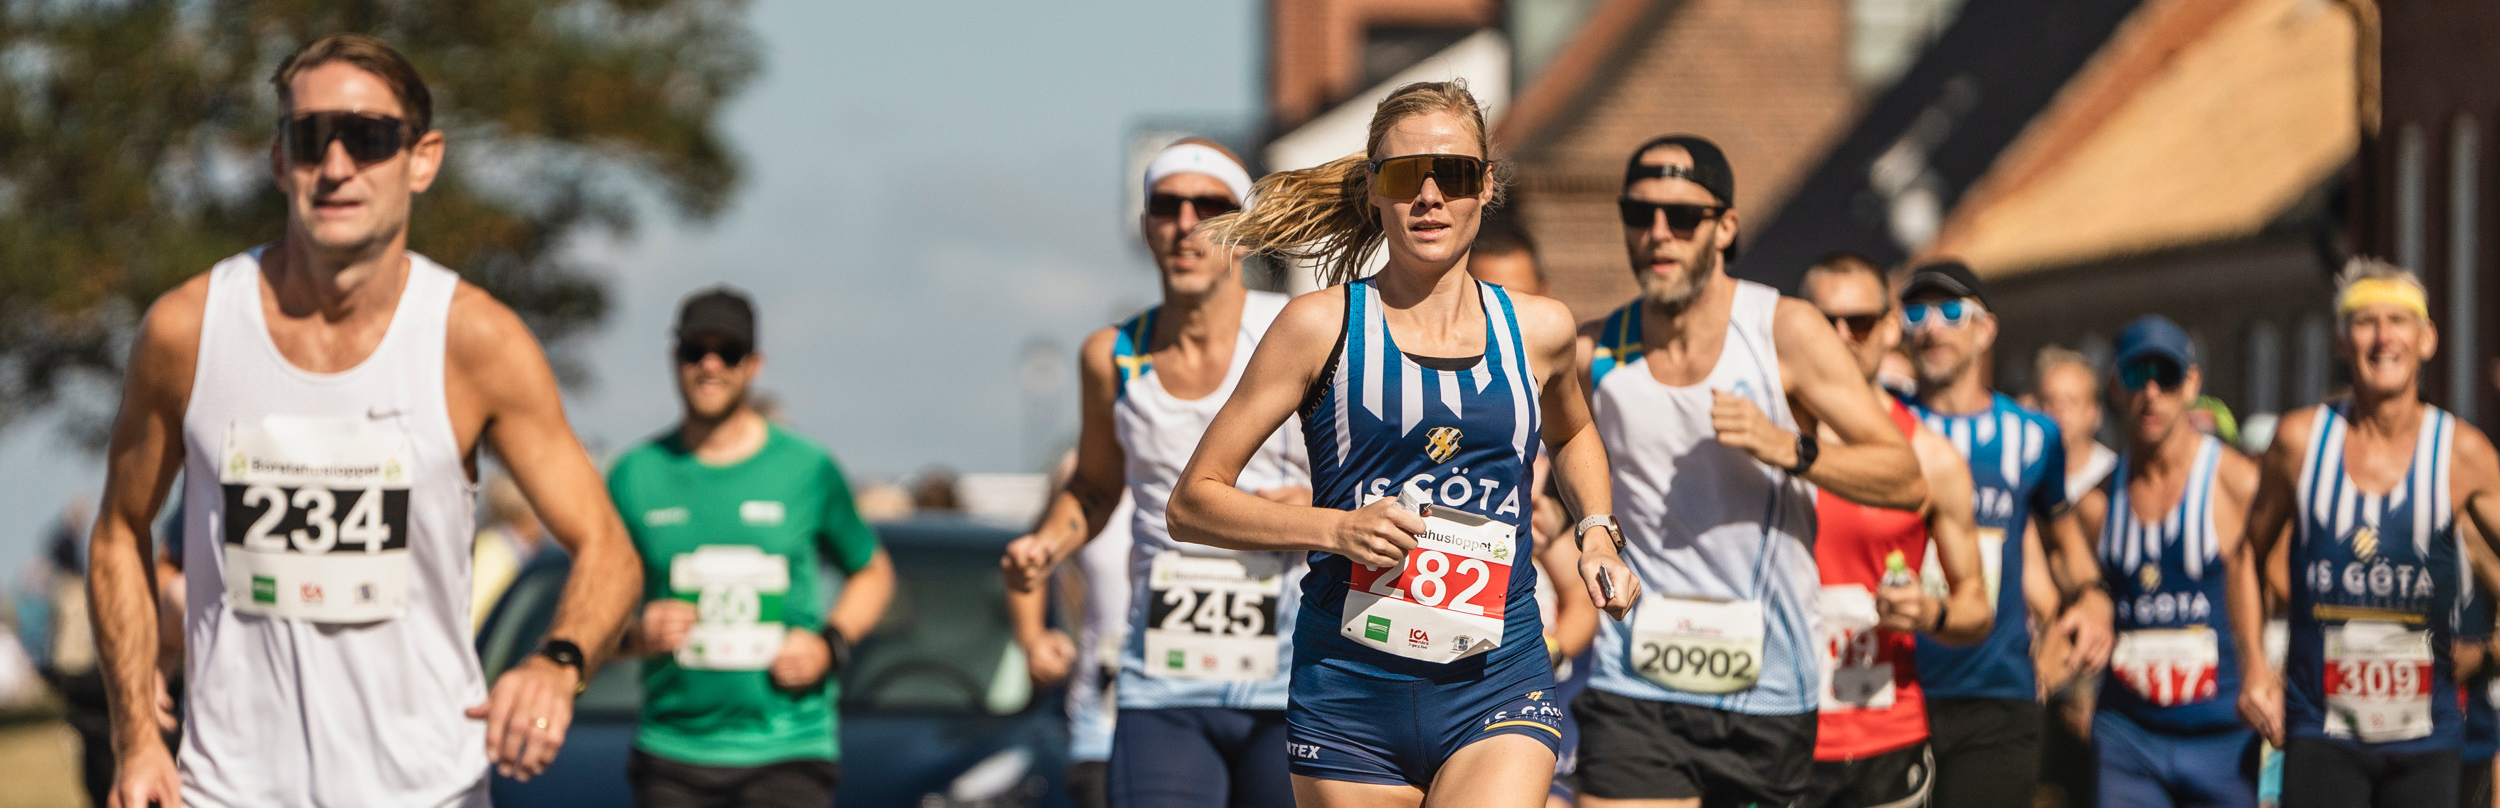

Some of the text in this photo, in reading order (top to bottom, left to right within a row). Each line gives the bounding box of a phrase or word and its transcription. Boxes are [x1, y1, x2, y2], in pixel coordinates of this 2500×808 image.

[242, 484, 391, 555] 234
[1366, 550, 1490, 616] 282
[2306, 556, 2435, 600] IS GÖTA
[1161, 587, 1265, 637] 245
[1409, 628, 1430, 642] ICA
[1638, 642, 1753, 680] 20902
[2336, 660, 2420, 703] 309
